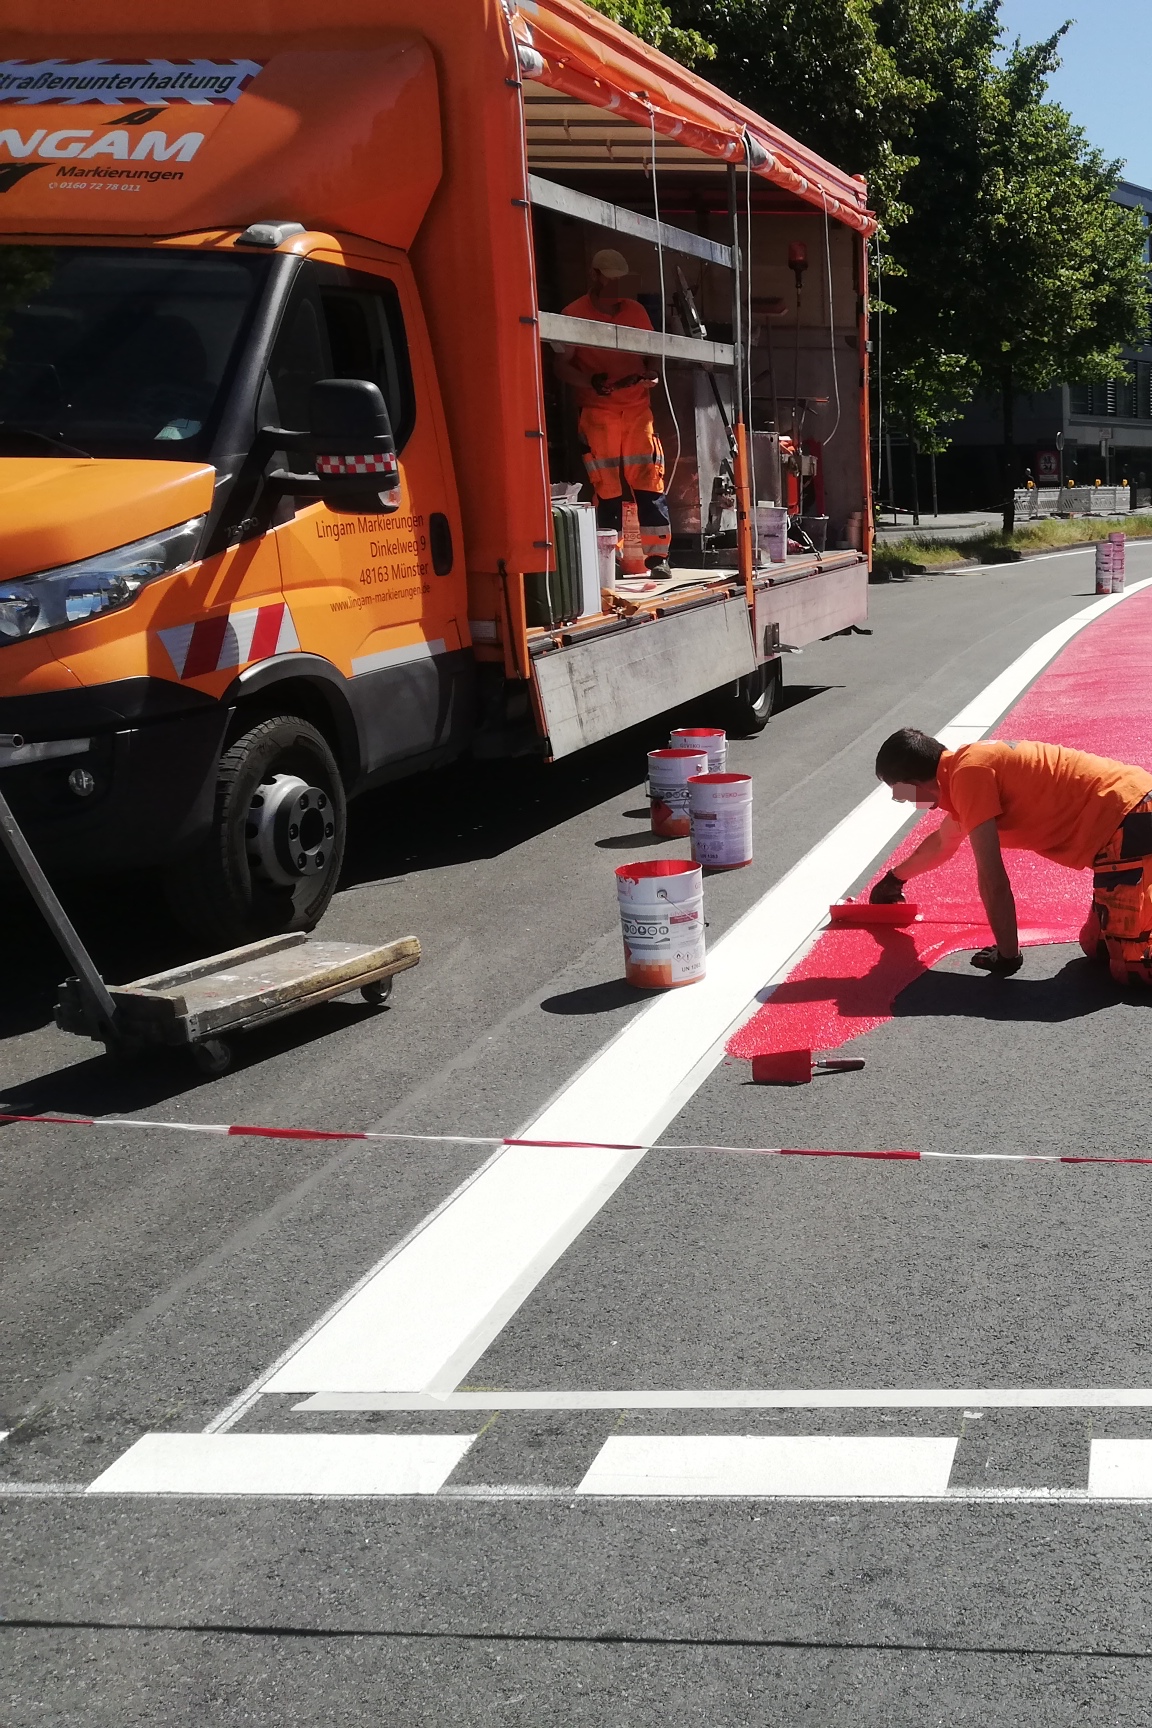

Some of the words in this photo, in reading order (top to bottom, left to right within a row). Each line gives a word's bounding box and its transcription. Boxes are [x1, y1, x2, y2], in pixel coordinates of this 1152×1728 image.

[55, 165, 184, 183] Markierungen
[59, 182, 87, 190] 0160
[89, 182, 103, 190] 72
[105, 183, 119, 191] 78
[120, 184, 141, 192] 011
[315, 520, 356, 542] Lingam
[357, 514, 424, 534] Markierungen
[370, 538, 419, 558] Dinkelweg
[420, 535, 426, 551] 9
[359, 566, 389, 586] 48163
[391, 562, 429, 581] Münster
[329, 584, 431, 613] www.lingam-markierungen.de
